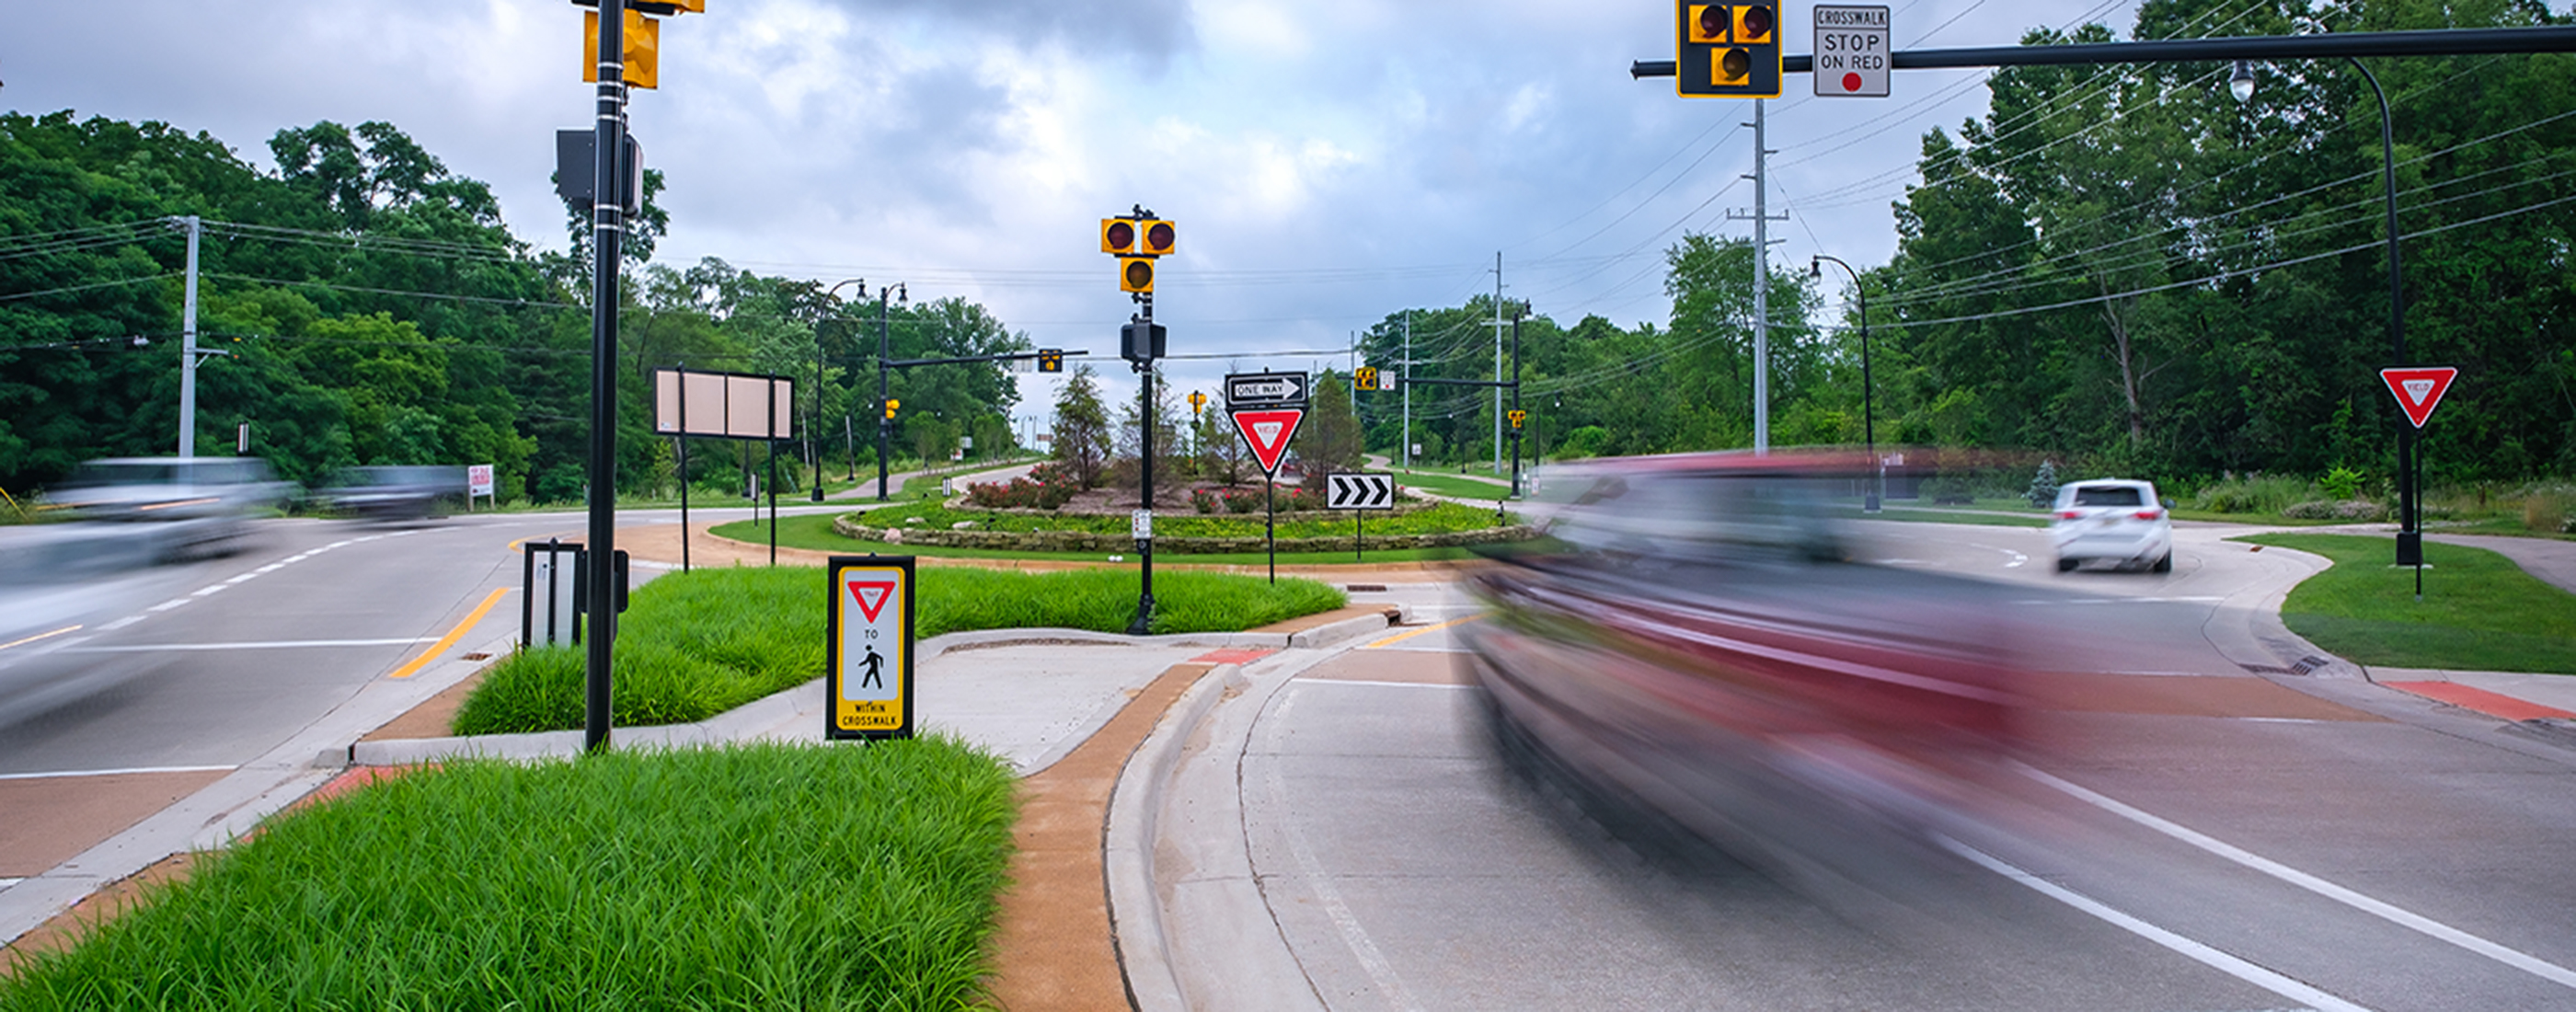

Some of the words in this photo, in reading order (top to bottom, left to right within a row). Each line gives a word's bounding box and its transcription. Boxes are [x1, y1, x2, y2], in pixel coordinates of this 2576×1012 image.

[1817, 10, 1886, 25] CROSSWALK
[1824, 34, 1880, 52] STOP
[1821, 55, 1844, 69] ON
[1851, 55, 1883, 69] RED
[1237, 385, 1259, 396] ONE
[1262, 385, 1282, 394] WAY
[2408, 383, 2430, 391] YIELD
[864, 628, 879, 639] TO
[855, 704, 886, 713] WITHIN
[842, 716, 897, 726] CROSSWALK
